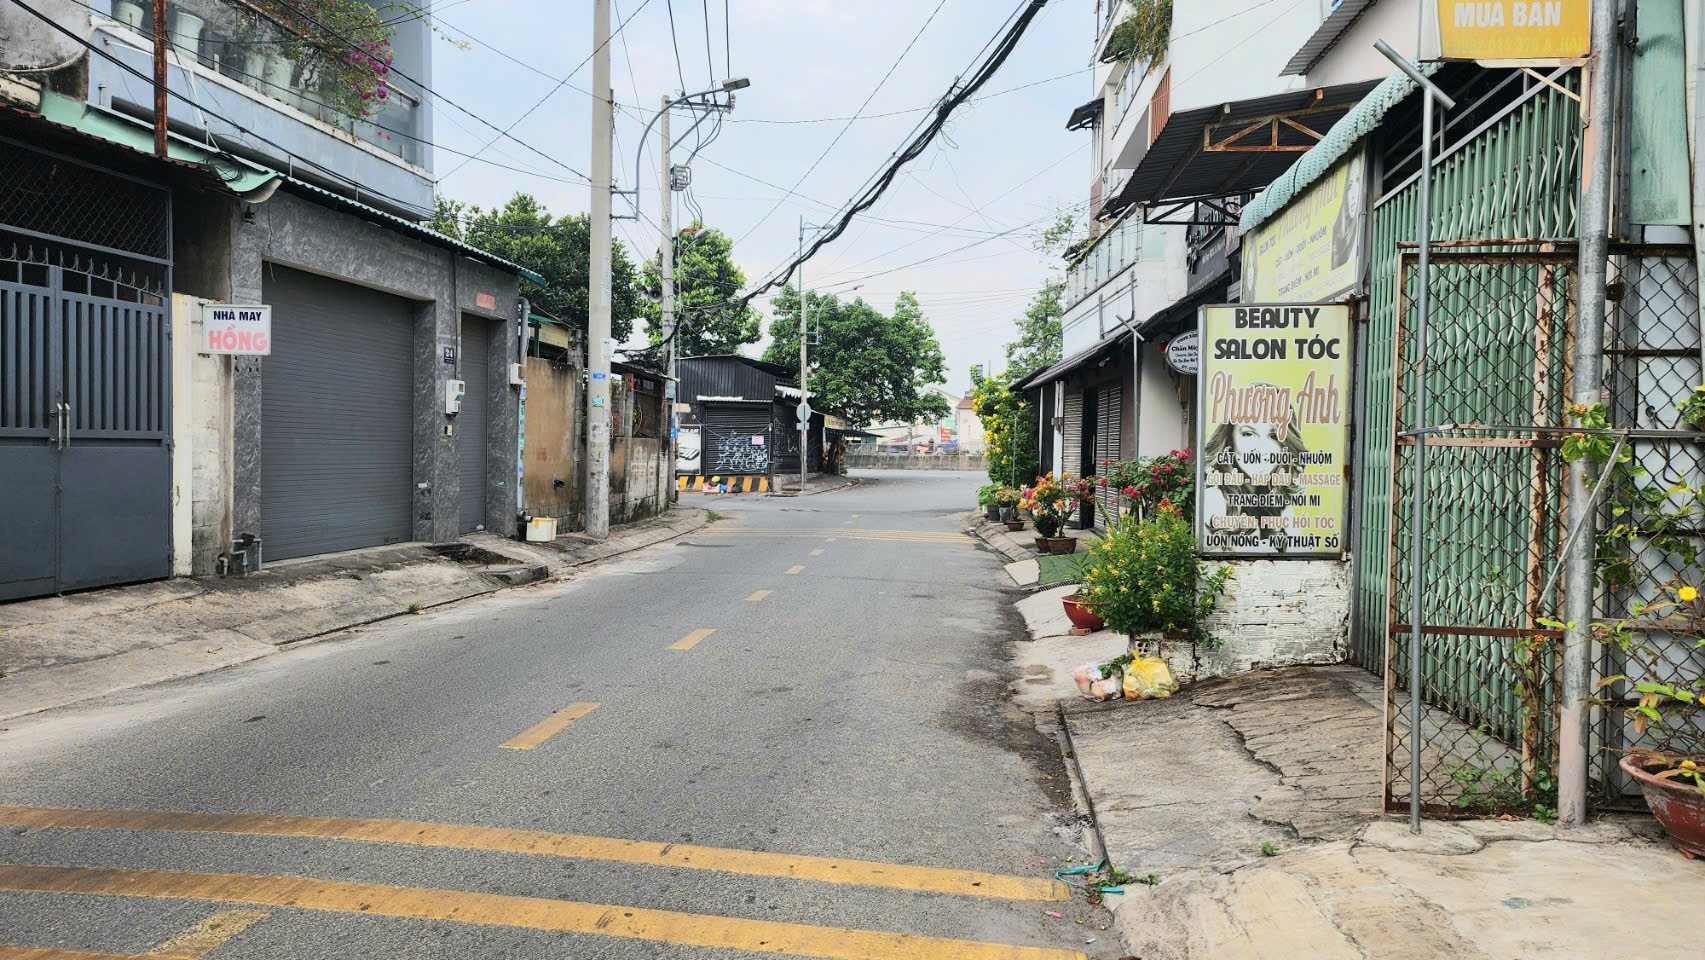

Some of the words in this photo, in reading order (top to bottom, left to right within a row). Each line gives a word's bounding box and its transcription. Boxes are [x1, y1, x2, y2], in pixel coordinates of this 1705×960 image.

[1454, 3, 1504, 28] MUA
[213, 309, 235, 320] NHÀ
[239, 311, 262, 321] MAY
[1235, 308, 1320, 329] BEAUTY
[208, 322, 268, 352] HỒNG
[1214, 338, 1287, 360] SALON
[1294, 333, 1340, 360] TÓC
[1296, 370, 1341, 432] Anh
[1243, 448, 1261, 464] UỐN
[1299, 449, 1332, 466] NHUỘM
[1299, 473, 1341, 485] MASSAGE
[1227, 494, 1257, 506] TRANG
[1260, 491, 1283, 506] ĐIỂM
[1291, 491, 1306, 506] NỐI
[1309, 495, 1320, 506] MI
[1293, 512, 1310, 528] HỒI
[1314, 514, 1335, 528] TÓC
[1207, 531, 1228, 546] UỐN
[1231, 533, 1259, 546] NÓNG
[1287, 533, 1321, 549] THUẬT
[1325, 532, 1340, 547] SỐ
